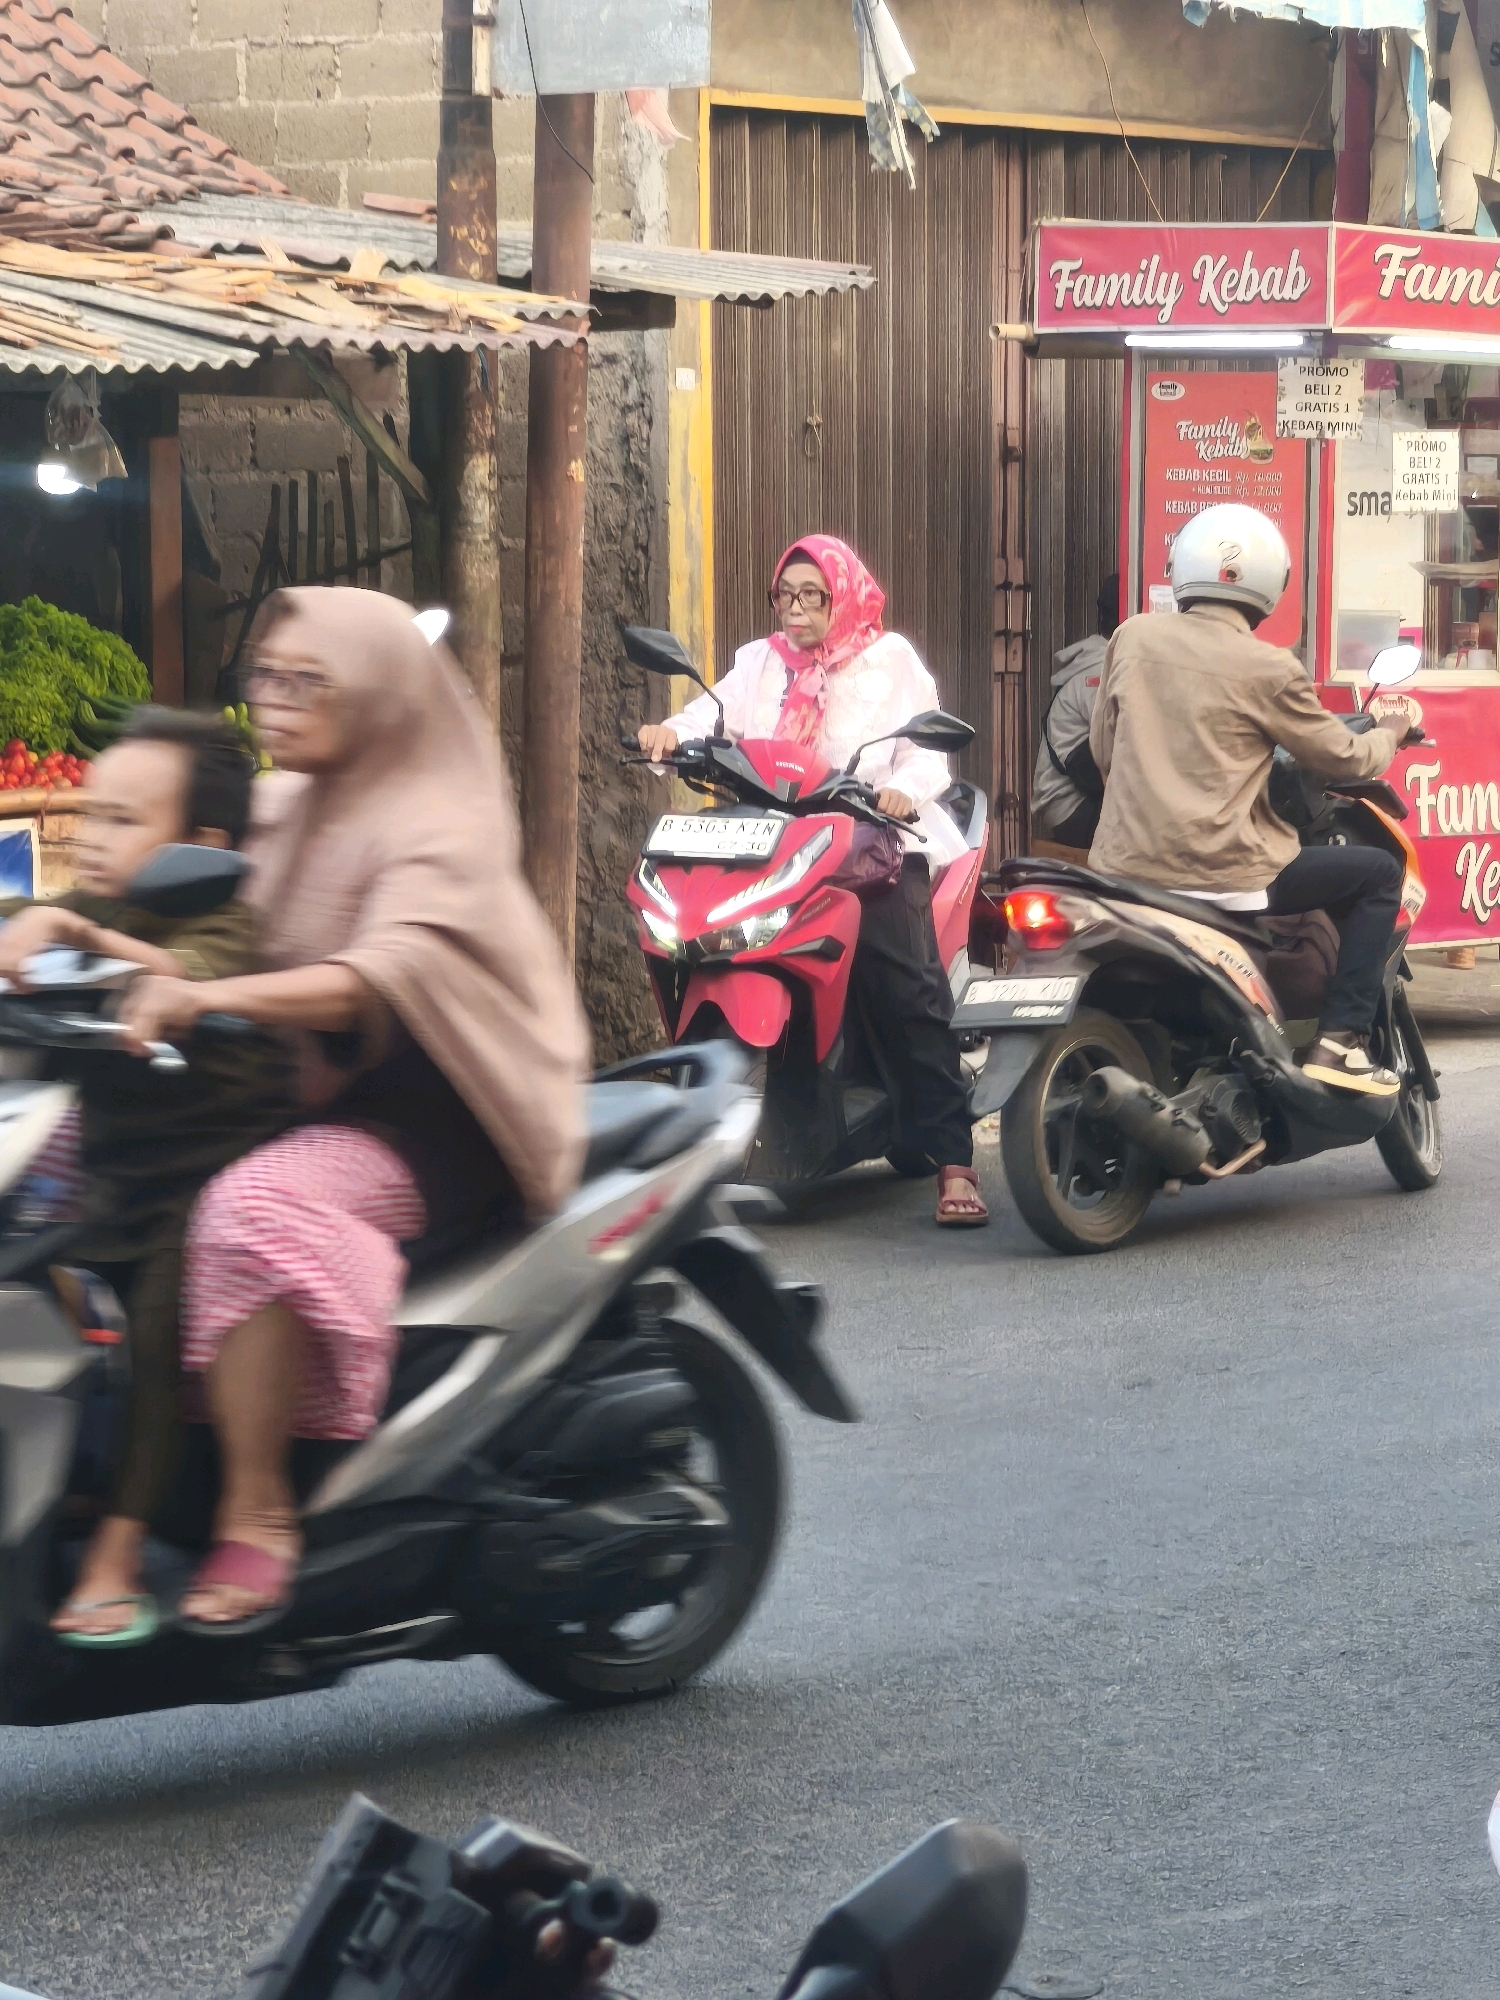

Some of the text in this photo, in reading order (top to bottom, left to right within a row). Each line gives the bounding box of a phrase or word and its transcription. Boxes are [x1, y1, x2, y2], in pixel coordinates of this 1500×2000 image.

[1049, 247, 1312, 324] Family Kebab
[1299, 366, 1349, 377] PROMO
[1304, 384, 1342, 395] BELI 2
[1295, 402, 1350, 413] GRATIS 1
[1176, 416, 1240, 443] Family
[1282, 420, 1357, 432] KEBAB MINI
[1406, 440, 1447, 452] PROMO
[1409, 456, 1441, 469] BELI 2
[1166, 468, 1200, 482] KEBAB
[1202, 469, 1231, 482] KECIL
[1402, 473, 1440, 485] GRATIS
[1395, 489, 1456, 501] Kebab Mini
[1165, 500, 1197, 514] KEBAB
[1405, 759, 1500, 838] Fam
[662, 819, 673, 832] B
